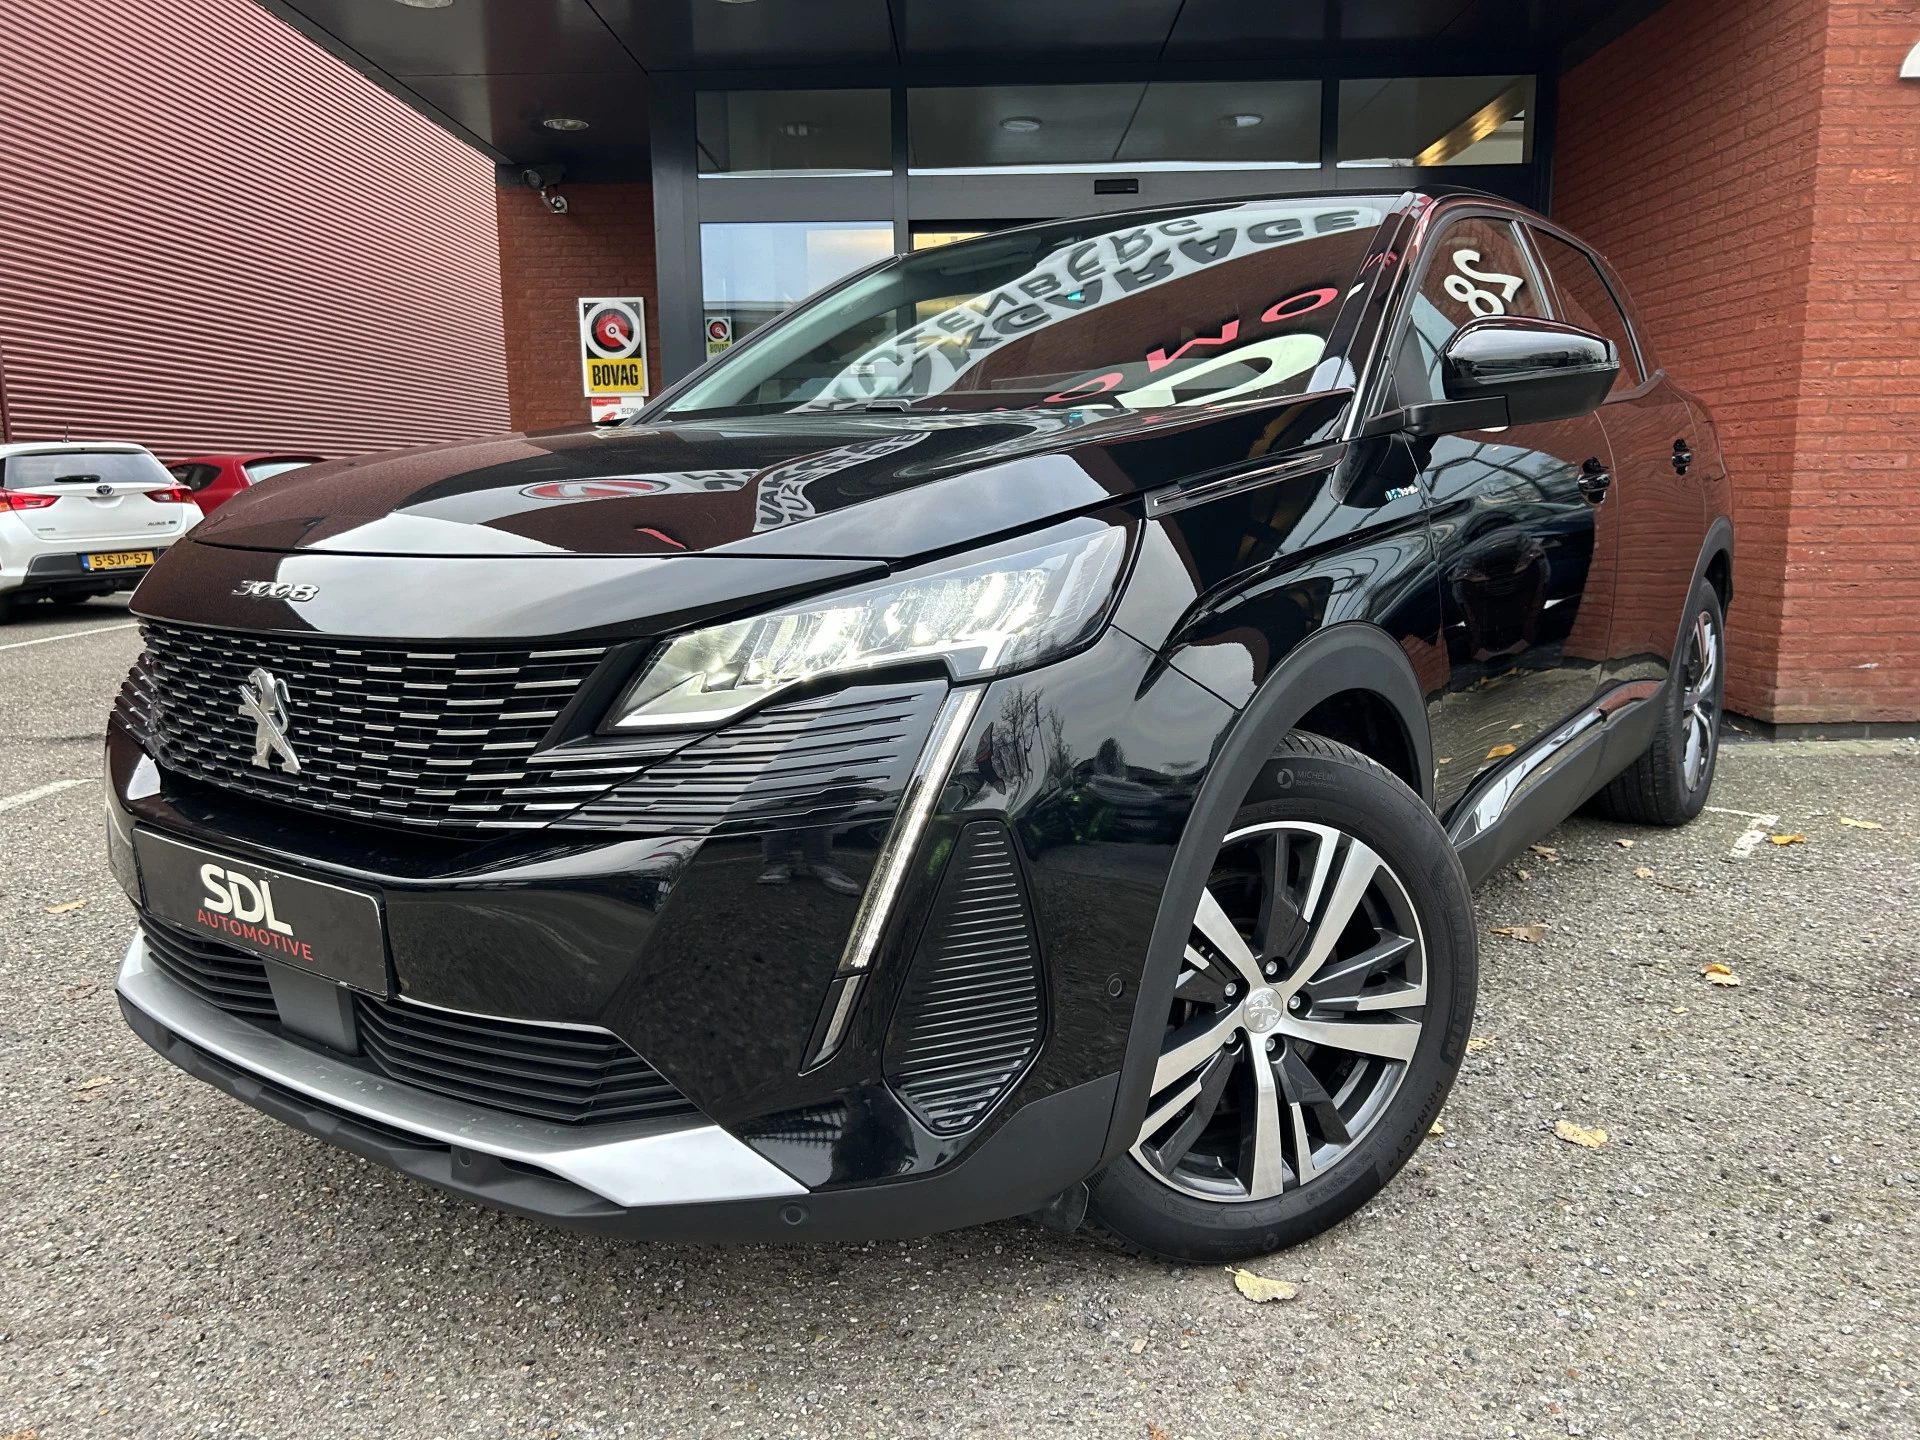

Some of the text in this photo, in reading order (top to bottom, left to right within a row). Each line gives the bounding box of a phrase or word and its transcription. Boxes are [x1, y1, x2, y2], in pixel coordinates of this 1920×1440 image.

[591, 363, 639, 386] BOVAG
[231, 579, 320, 602] 3008
[200, 863, 294, 936] SDL
[197, 908, 315, 963] AUTOMOTIVE
[1395, 1080, 1444, 1159] PRIMACY
